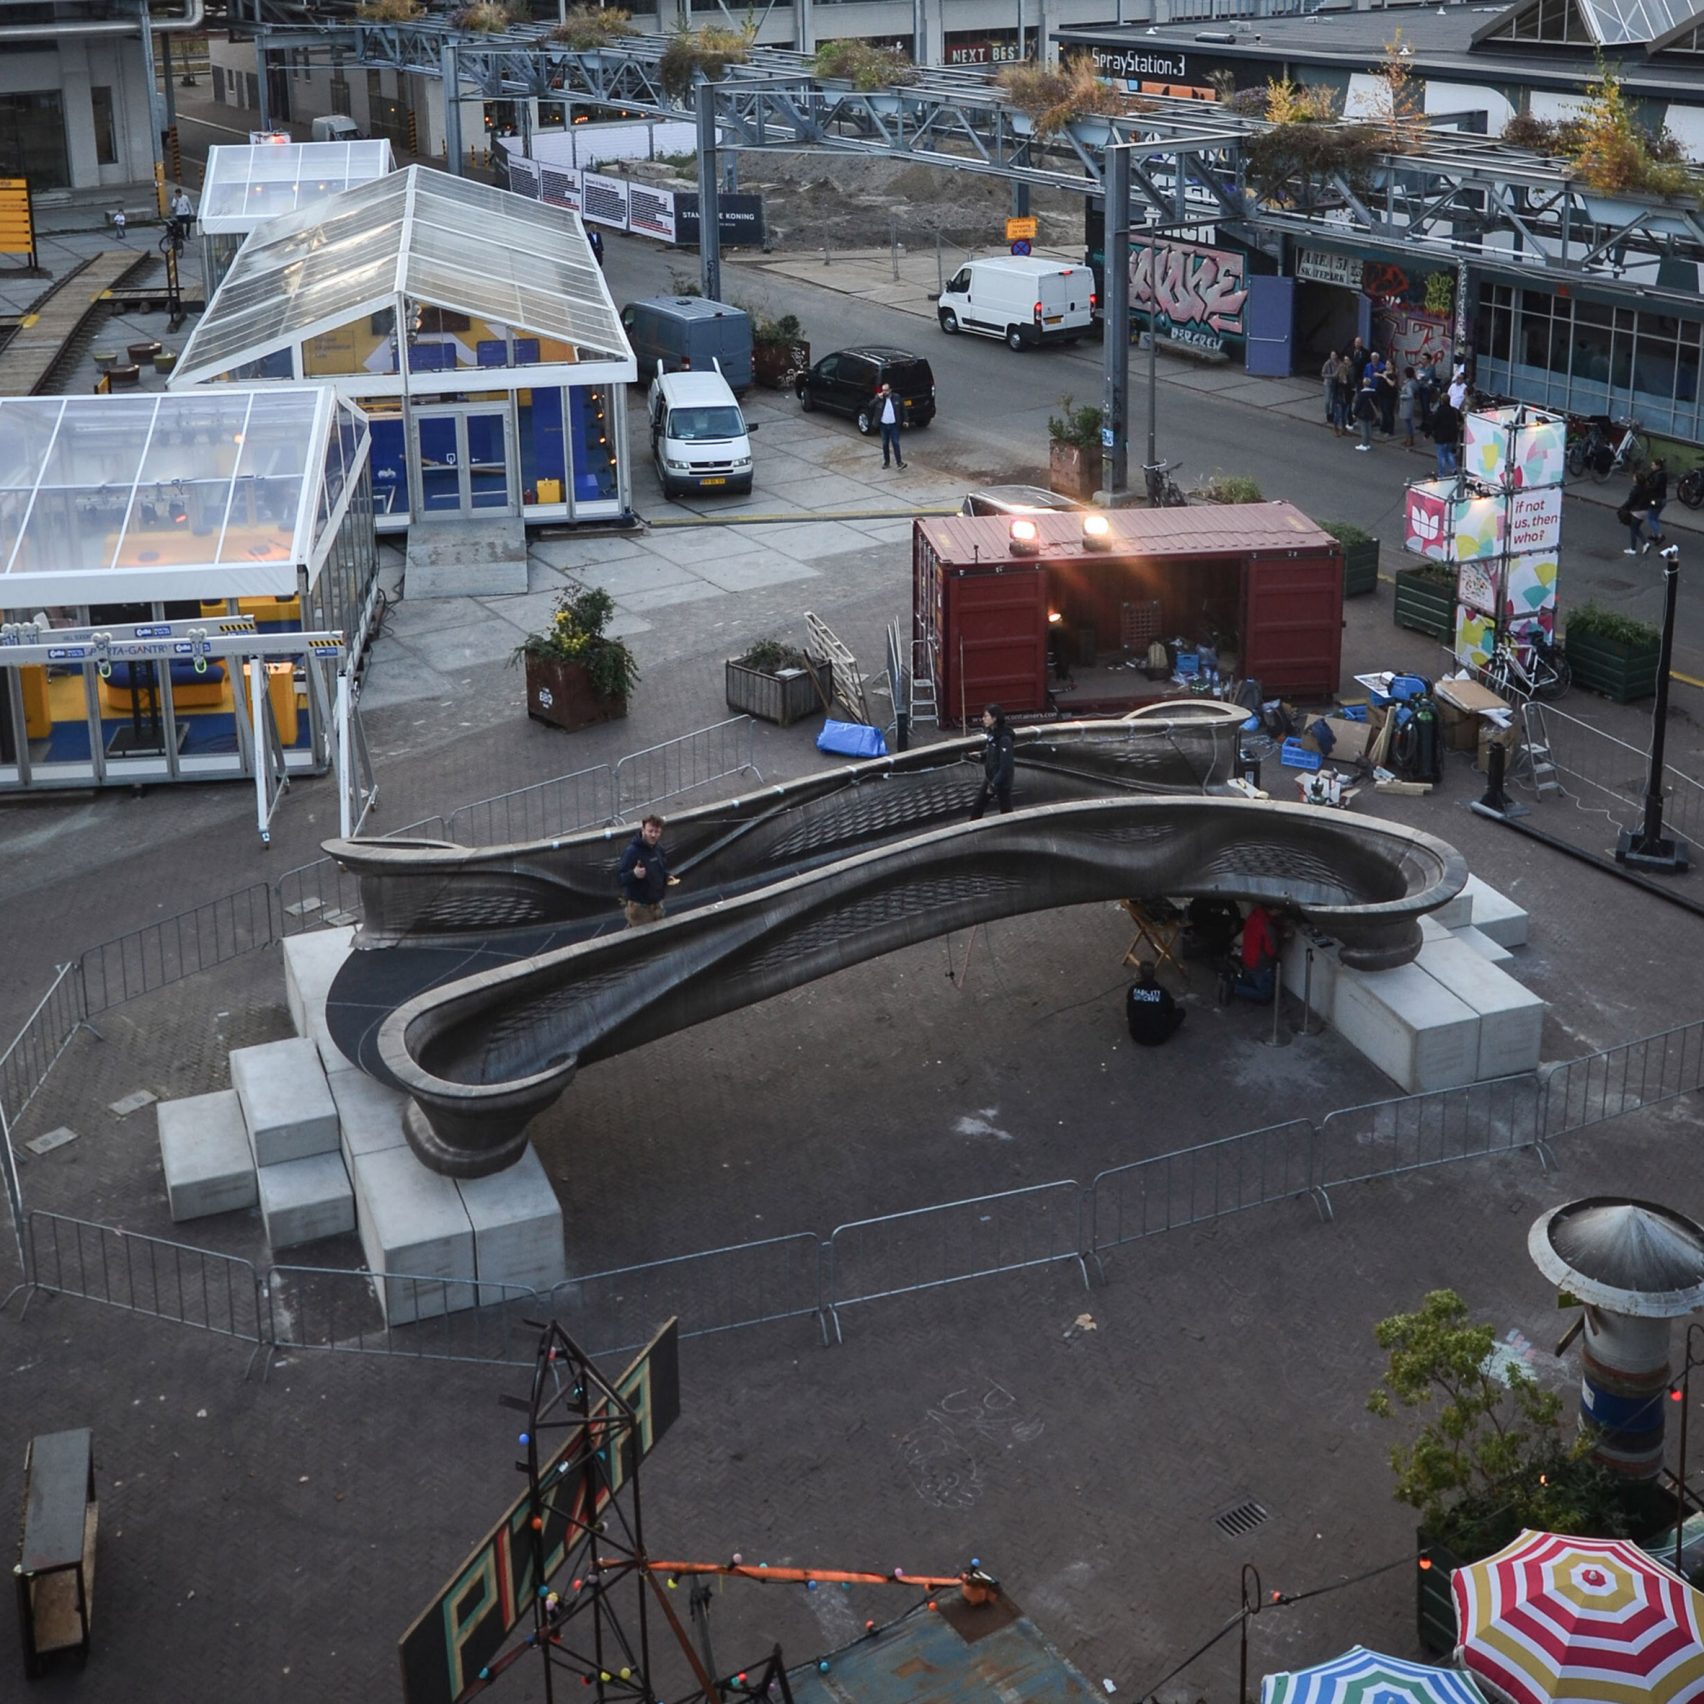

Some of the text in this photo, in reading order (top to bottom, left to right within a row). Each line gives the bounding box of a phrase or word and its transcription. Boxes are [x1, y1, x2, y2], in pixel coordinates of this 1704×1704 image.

[952, 48, 985, 63] NEXT
[1092, 47, 1186, 76] SprayStation.3
[725, 212, 755, 220] KONING
[1515, 500, 1545, 513] if not
[1532, 514, 1558, 527] then
[1513, 530, 1545, 544] who?
